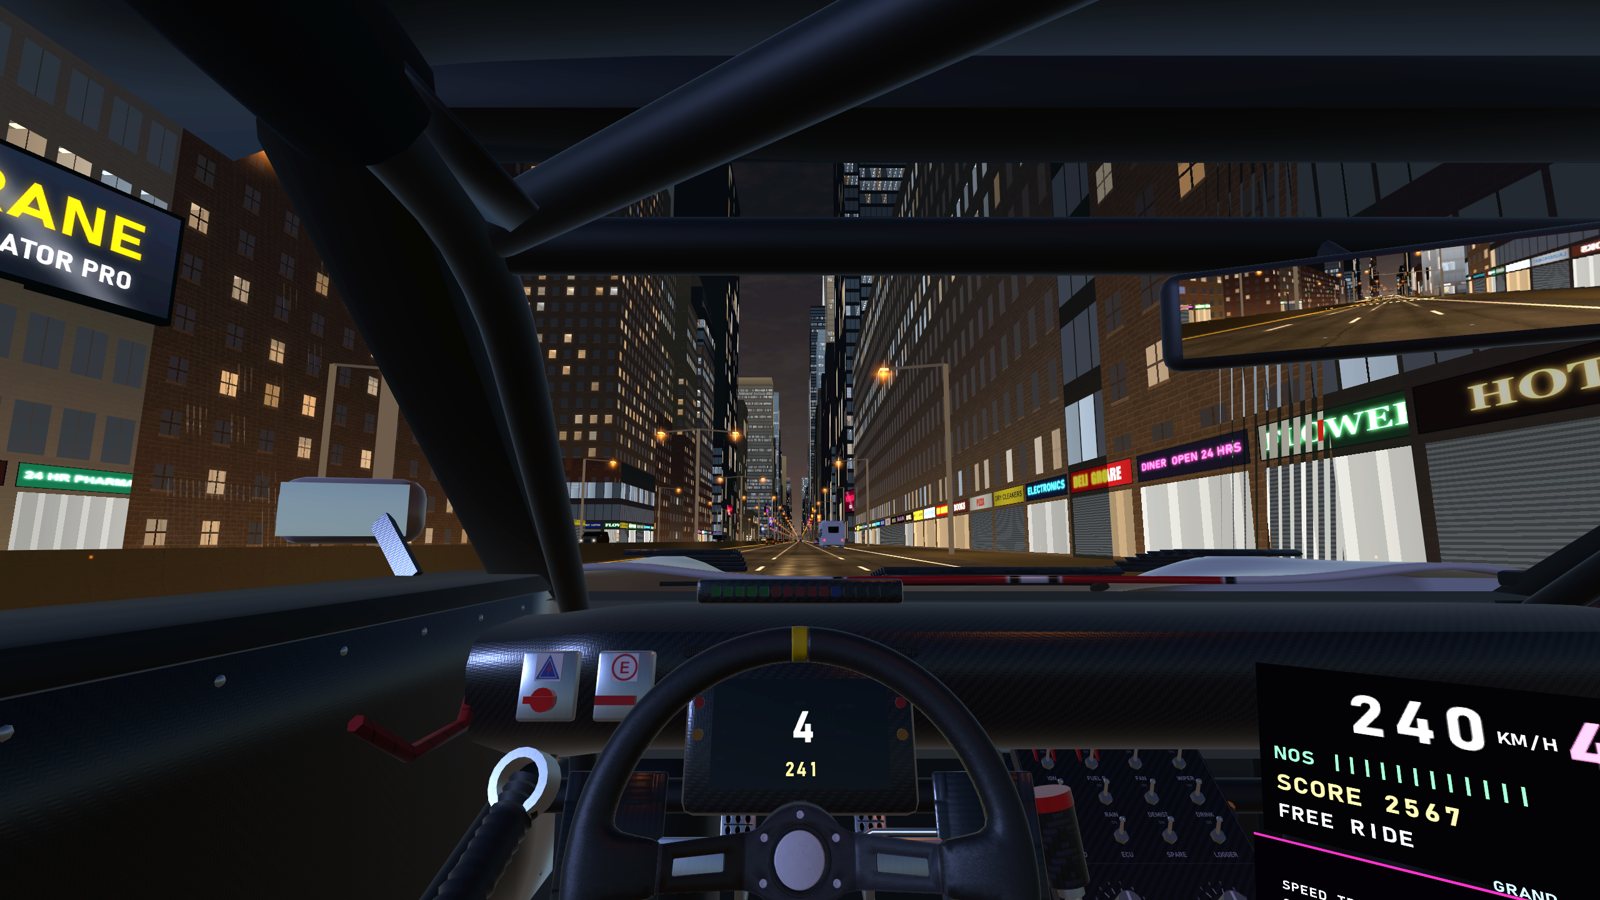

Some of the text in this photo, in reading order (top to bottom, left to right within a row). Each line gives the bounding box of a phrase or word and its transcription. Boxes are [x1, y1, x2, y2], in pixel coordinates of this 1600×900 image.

[0, 170, 147, 261] ANE
[0, 233, 132, 290] ATOR PRO
[1467, 357, 1600, 411] HOT
[1141, 441, 1242, 472] DINER OPEN 24 HRS
[23, 469, 43, 481] 24
[47, 472, 70, 483] HR
[1027, 479, 1065, 496] ELECTRONICS
[620, 661, 629, 674] E
[793, 710, 814, 743] 4
[1350, 694, 1559, 753] 240 KM/H
[785, 761, 816, 777] 241
[1273, 745, 1315, 765] NOS
[1276, 773, 1460, 827] SCORE 2567
[1278, 802, 1414, 848] FREE RIDE
[1282, 879, 1328, 900] SPEED
